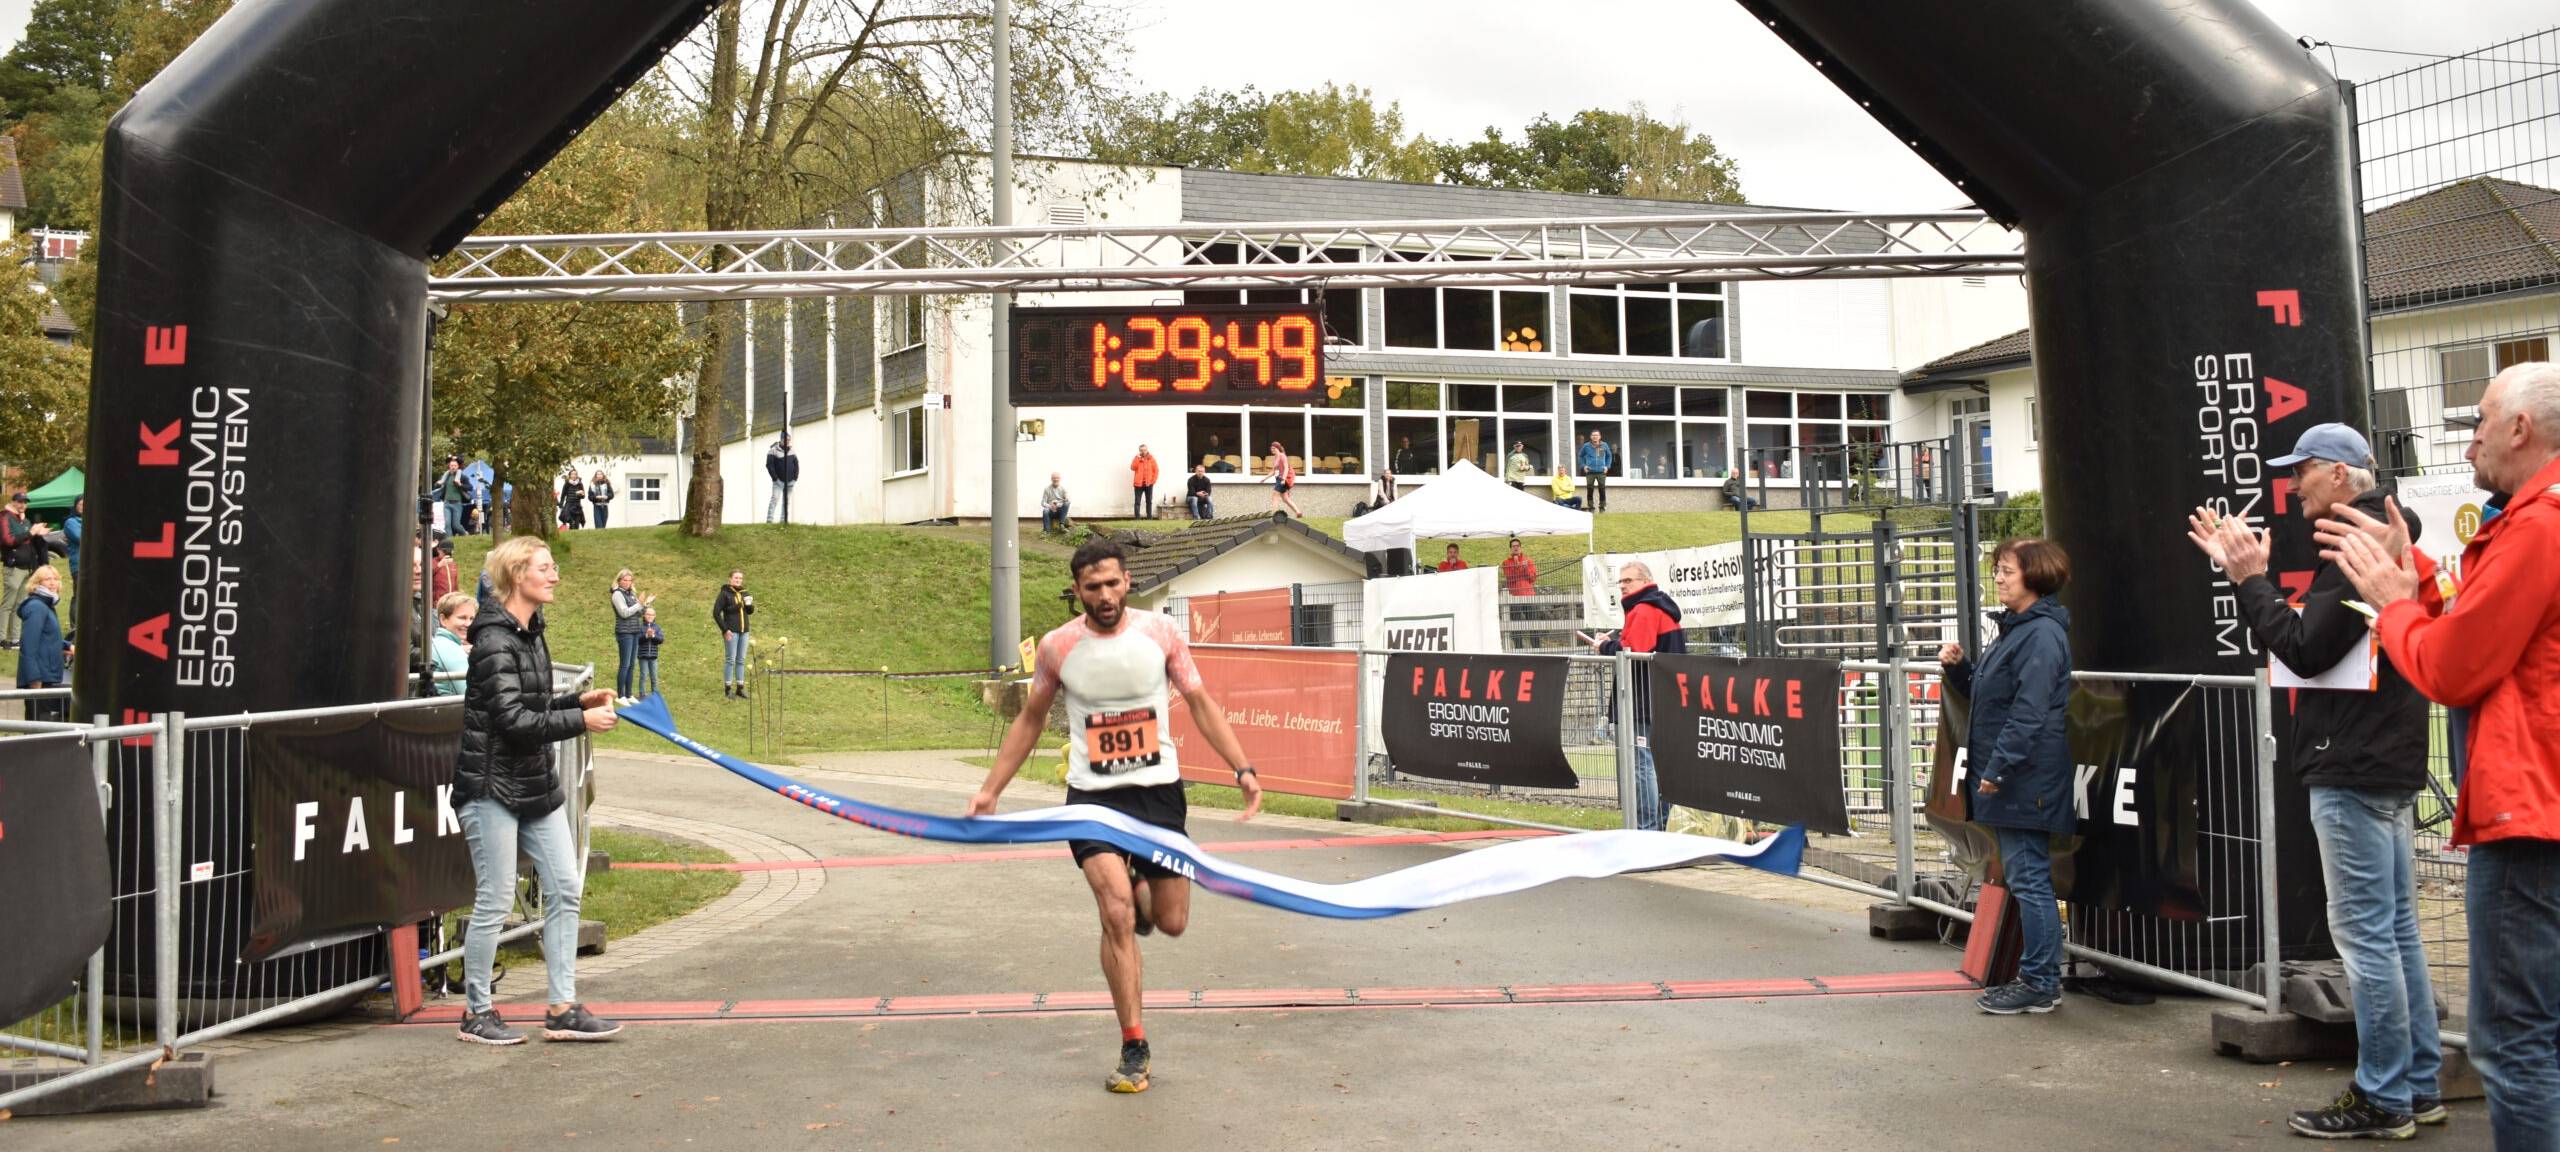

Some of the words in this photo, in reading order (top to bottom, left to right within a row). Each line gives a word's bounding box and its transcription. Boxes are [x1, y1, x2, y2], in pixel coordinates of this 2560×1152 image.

[1093, 315, 1317, 392] 1:29:49
[2194, 354, 2229, 485] SPORT
[219, 387, 250, 547] SYSTEM
[122, 325, 188, 747] FALKE
[176, 385, 220, 687] ERGONOMIC
[1703, 561, 1710, 580] &
[210, 563, 241, 688] SPORT
[1412, 665, 1535, 702] FALKE
[1675, 672, 1804, 719] FALKE
[1251, 709, 1280, 729] Liebe.
[1283, 711, 1344, 735] Lebensart.
[1428, 702, 1510, 725] ERGONOMIC
[1430, 723, 1463, 738] SPORT
[1466, 725, 1511, 743] SYSTEM
[1698, 716, 1784, 747] ERGONOMIC
[1099, 727, 1145, 754] 891
[1697, 741, 1737, 762] SPORT
[1740, 746, 1786, 770] SYSTEM
[1951, 746, 2139, 826] FKE
[294, 783, 461, 862] FALK
